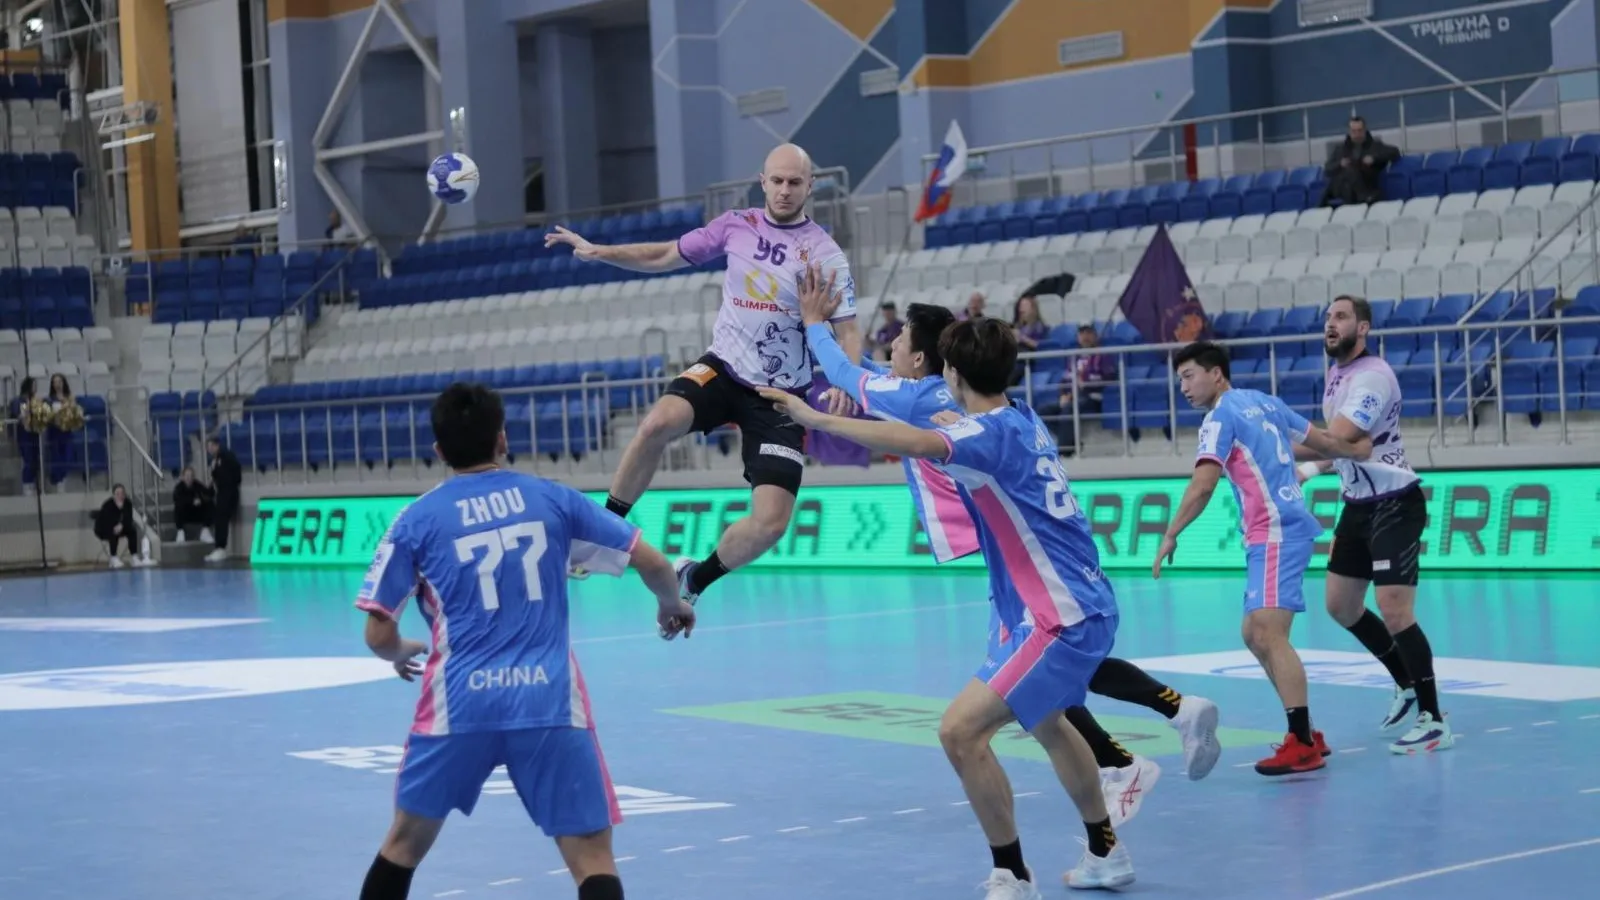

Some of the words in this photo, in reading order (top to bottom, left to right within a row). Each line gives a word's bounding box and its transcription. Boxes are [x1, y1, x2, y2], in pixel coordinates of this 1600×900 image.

[1410, 13, 1490, 37] ТРИБУНА
[1438, 28, 1491, 45] TRIBUNE
[733, 297, 790, 316] OLIMPBT
[456, 487, 526, 527] ZHOU
[455, 521, 548, 611] 77
[468, 665, 549, 691] CHINA
